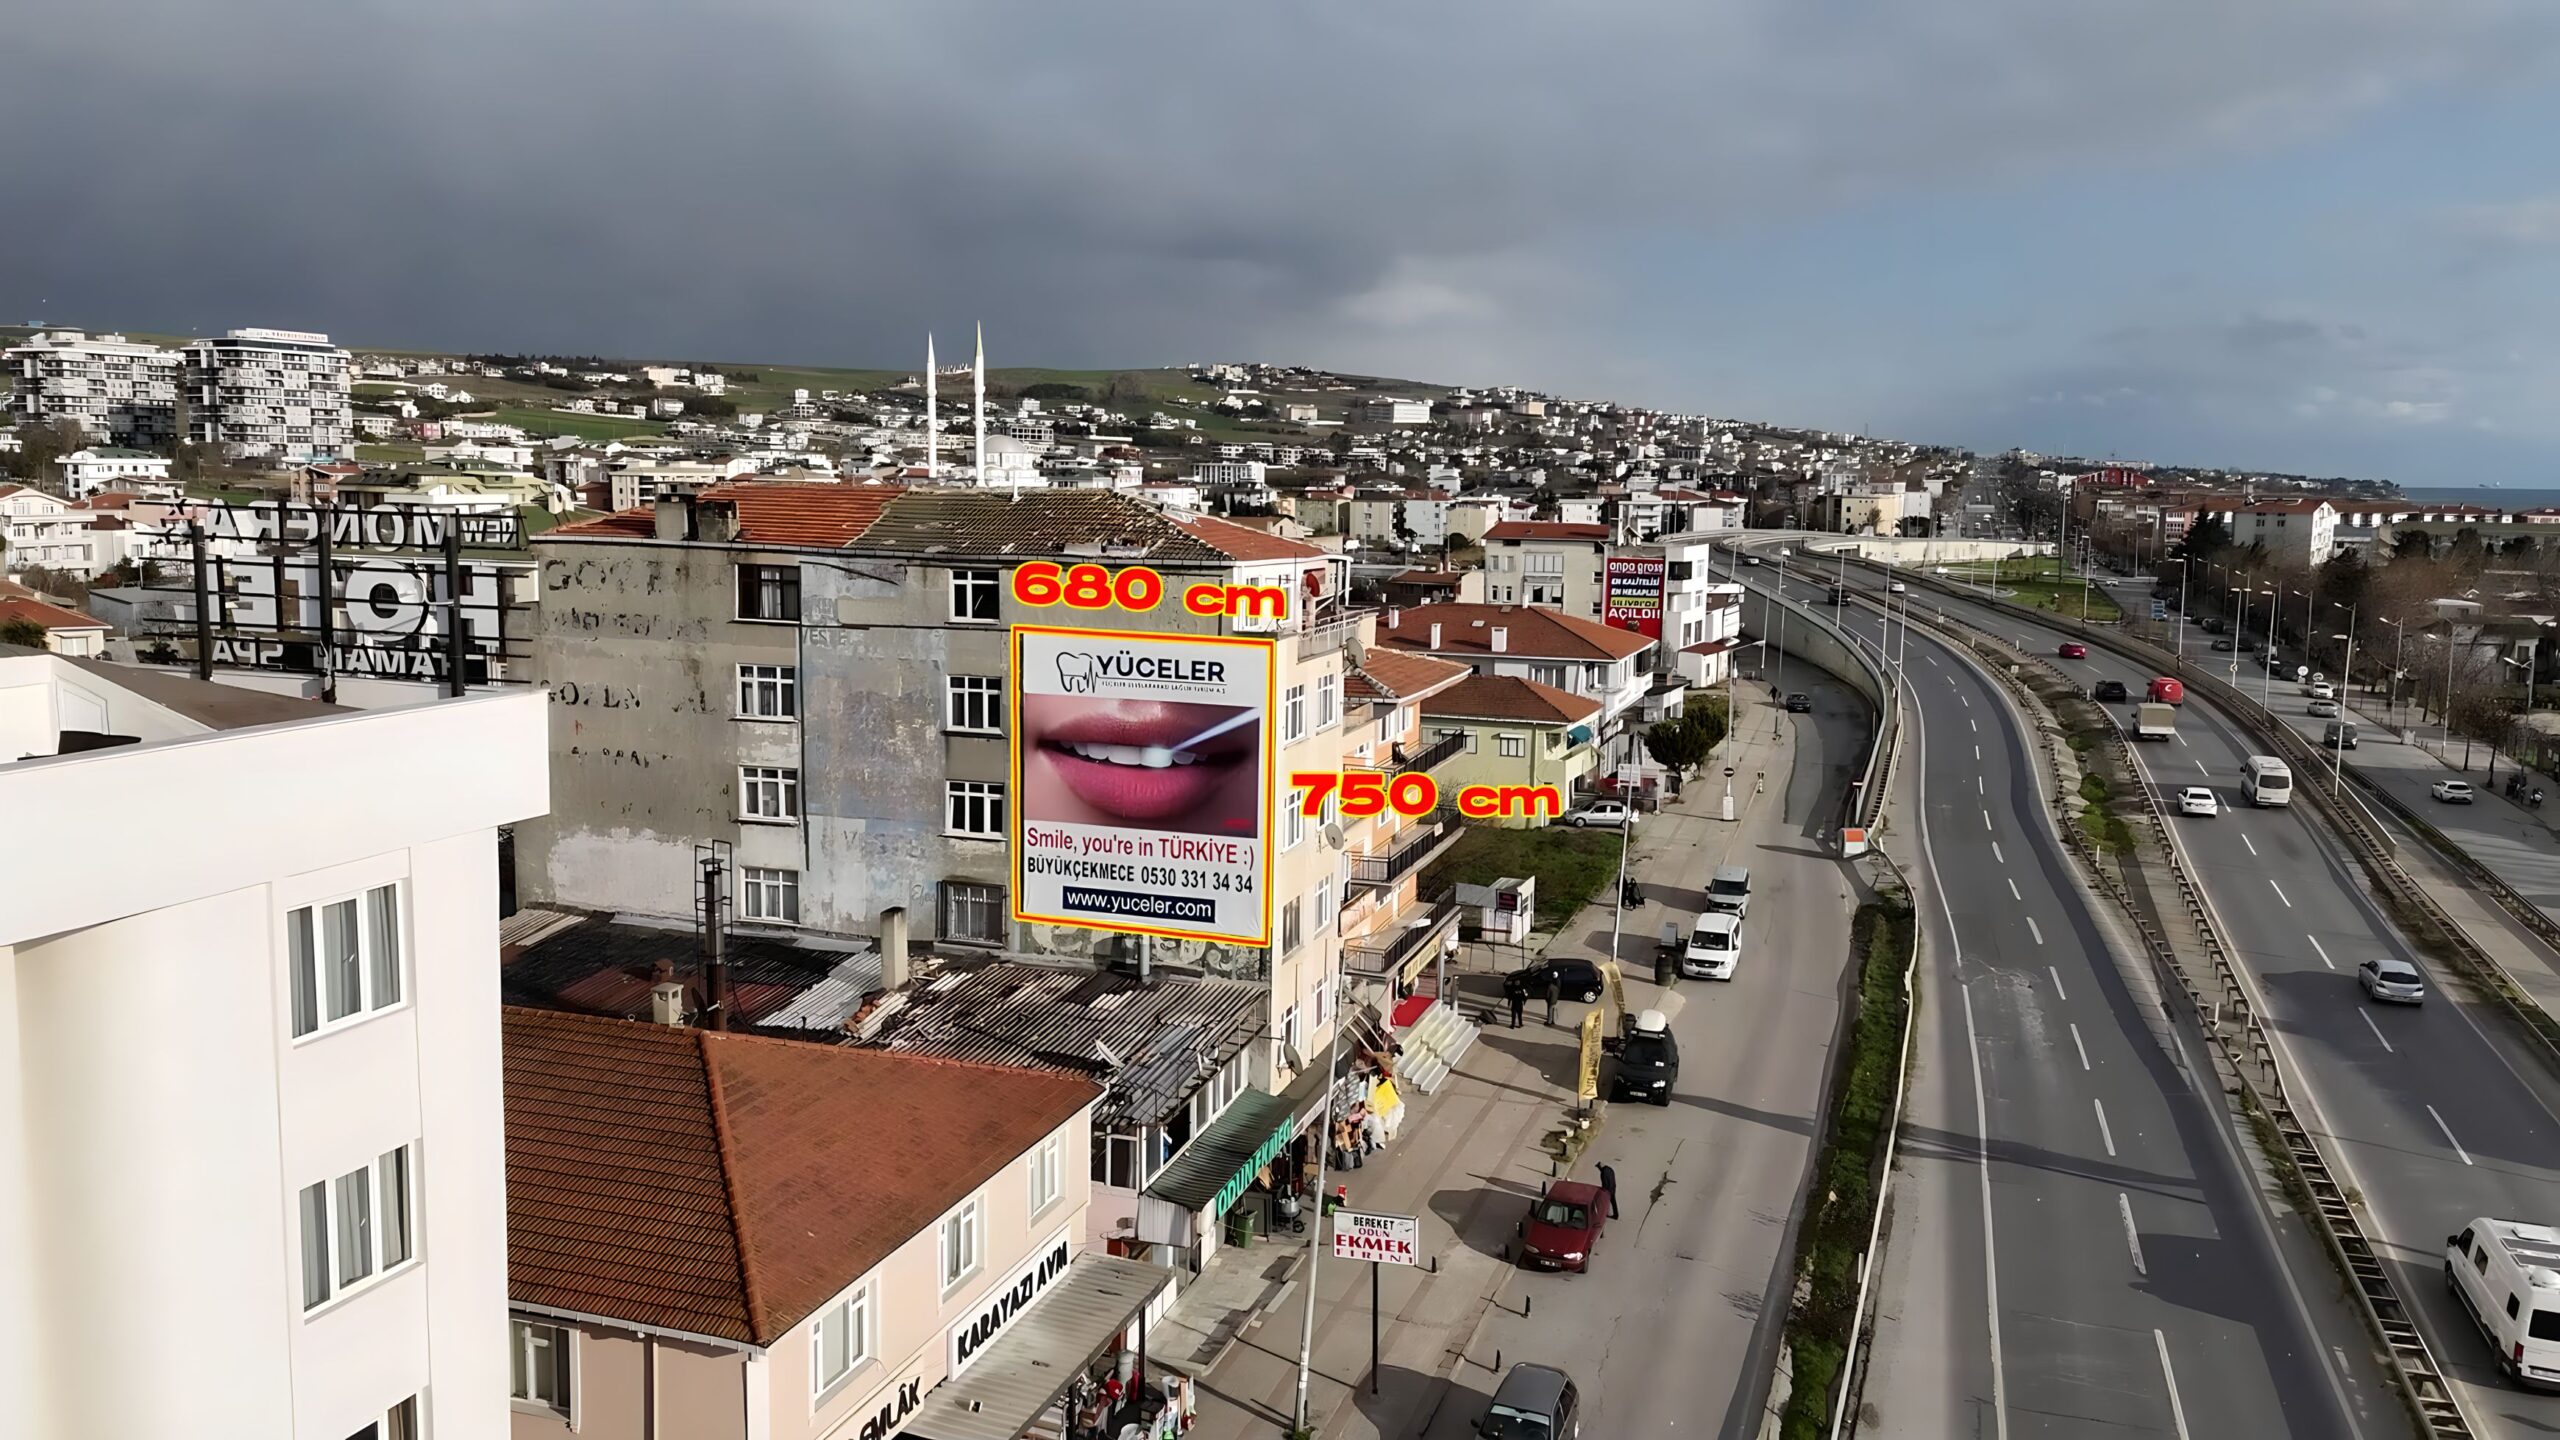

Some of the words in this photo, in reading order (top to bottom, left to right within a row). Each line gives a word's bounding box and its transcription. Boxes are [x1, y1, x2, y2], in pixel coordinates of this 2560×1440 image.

[1608, 608, 1660, 620] AÇILDI!
[1096, 650, 1226, 683] YÜCELER
[1027, 827, 1078, 853] Smile,
[1082, 834, 1133, 856] you're
[1138, 837, 1153, 857] in
[1158, 835, 1238, 864] TÜRKİYE
[1028, 855, 1134, 882] BÜYÜKÇEKMECE
[1141, 868, 1176, 886] 0530
[1181, 870, 1206, 889] 331
[1212, 872, 1230, 891] 34
[1235, 875, 1253, 894] 34
[1067, 891, 1212, 918] www.yuceler.com
[1217, 1158, 1254, 1217] ODUN
[1353, 1216, 1394, 1230] BEREKET
[1358, 1228, 1390, 1238] ODUN
[1336, 1234, 1411, 1254] EKMEK
[958, 1272, 1033, 1365] KARAYAZI
[1036, 1241, 1068, 1292] AVM
